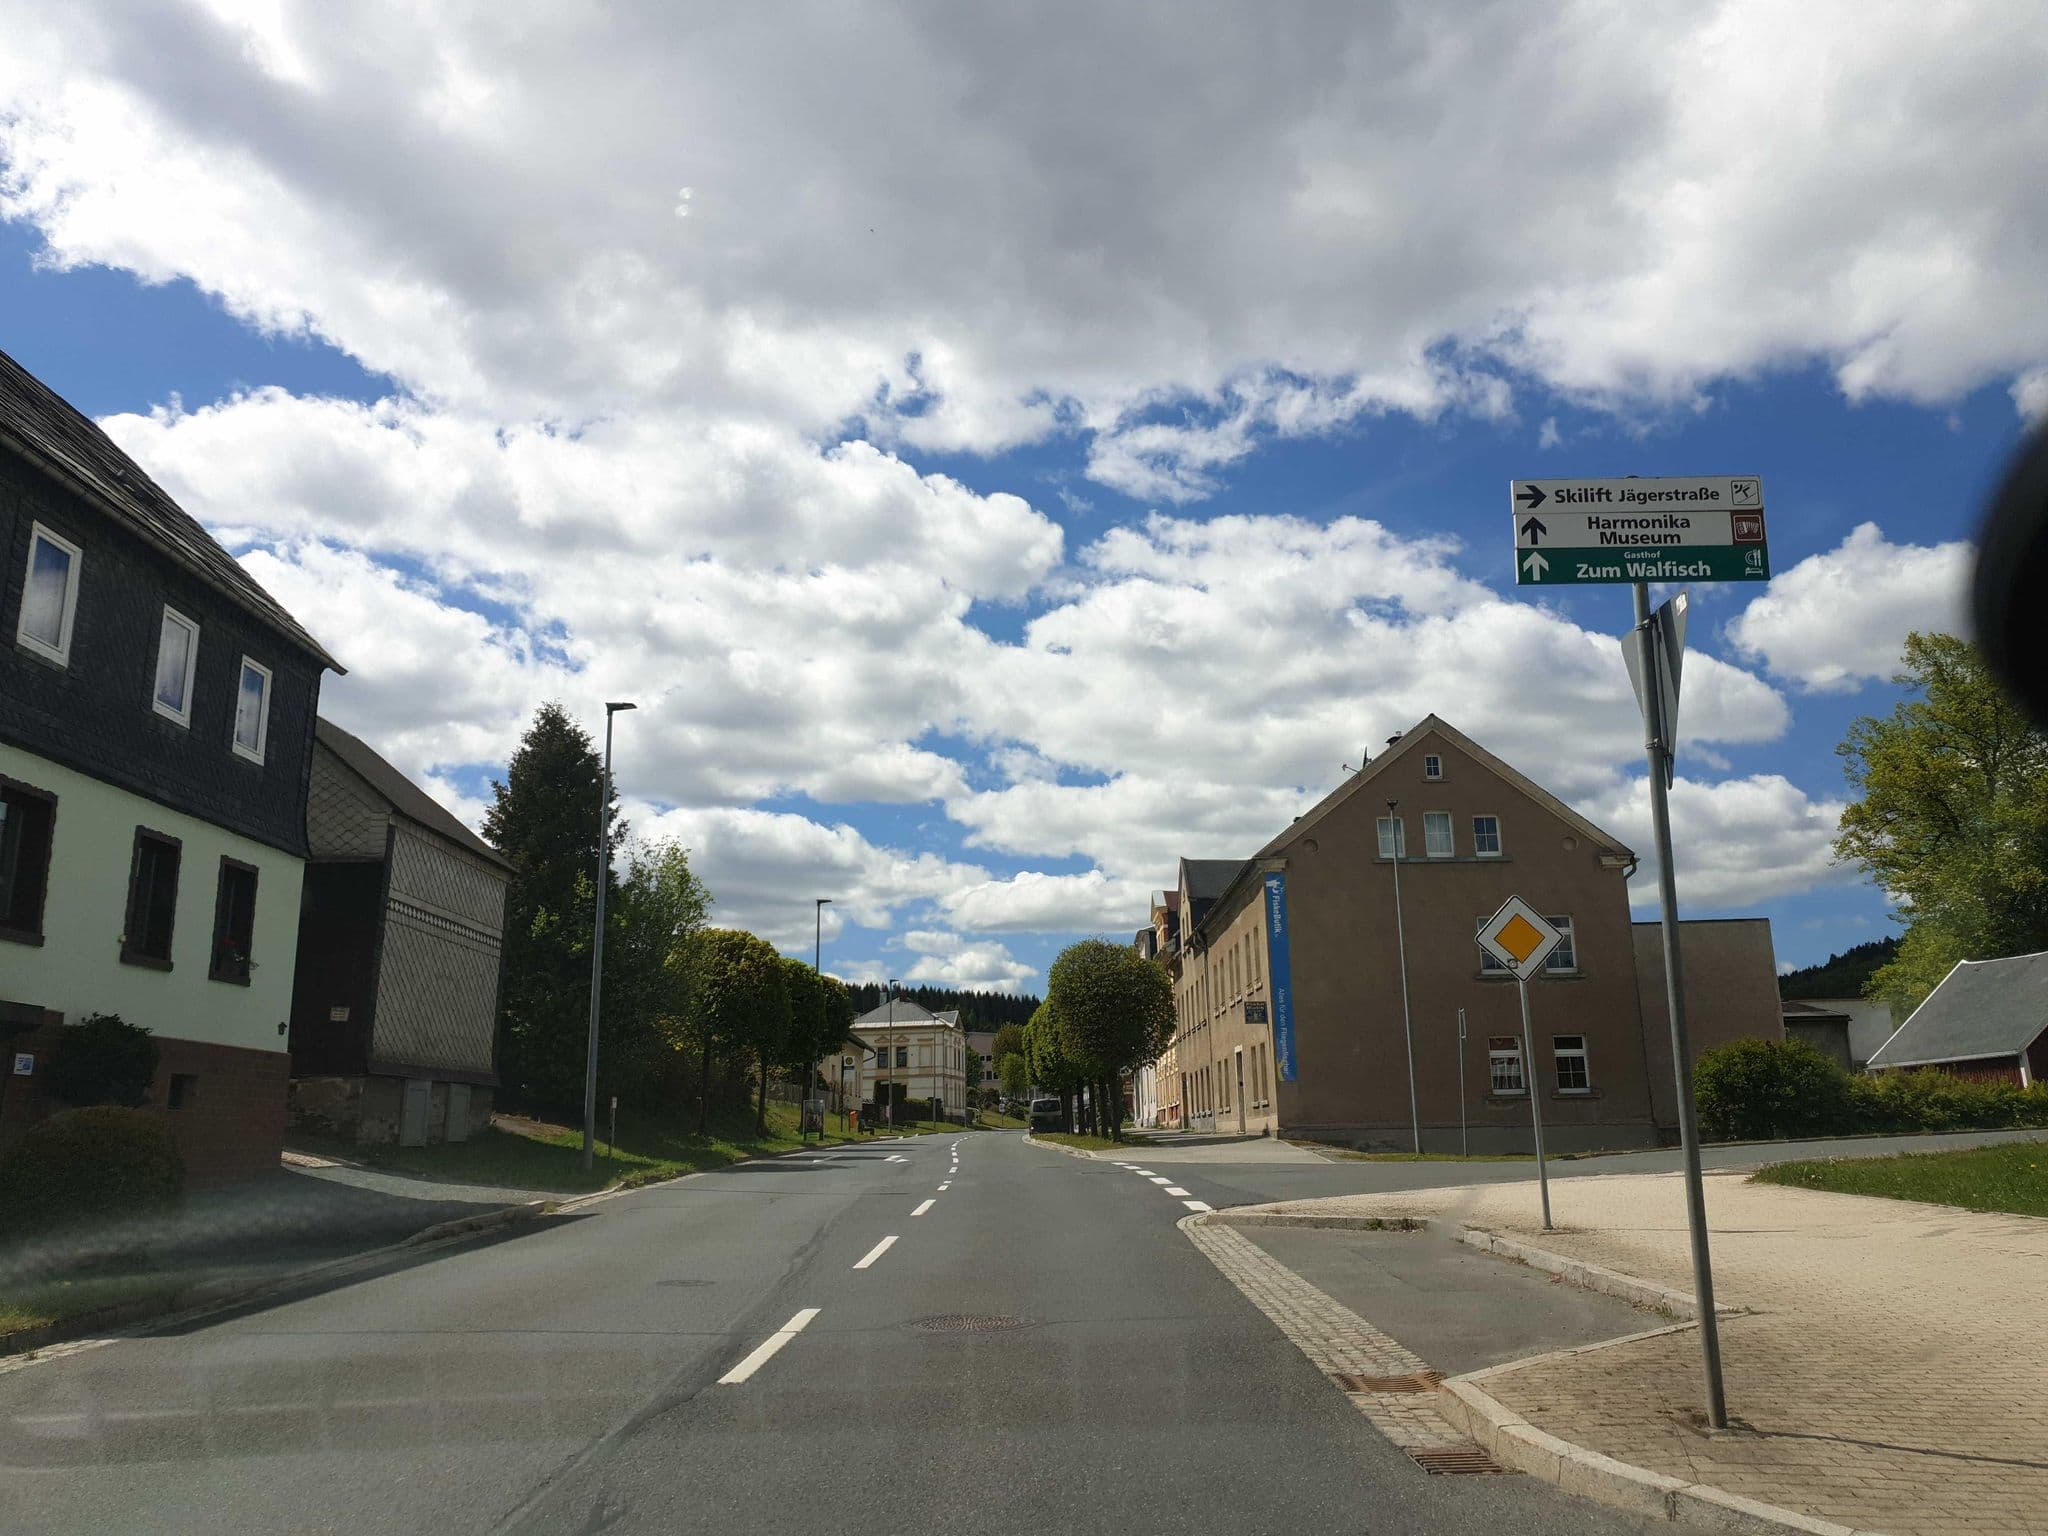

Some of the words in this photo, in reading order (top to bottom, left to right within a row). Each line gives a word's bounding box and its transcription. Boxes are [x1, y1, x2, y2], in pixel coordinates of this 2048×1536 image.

[1554, 487, 1613, 504] Skilift
[1618, 487, 1720, 505] Jägerstraße
[1587, 514, 1690, 530] Harmonika
[1600, 530, 1681, 545] Museum
[1624, 550, 1661, 559] Gasthof
[1576, 563, 1621, 578] Zum
[1626, 560, 1711, 577] Walfisch
